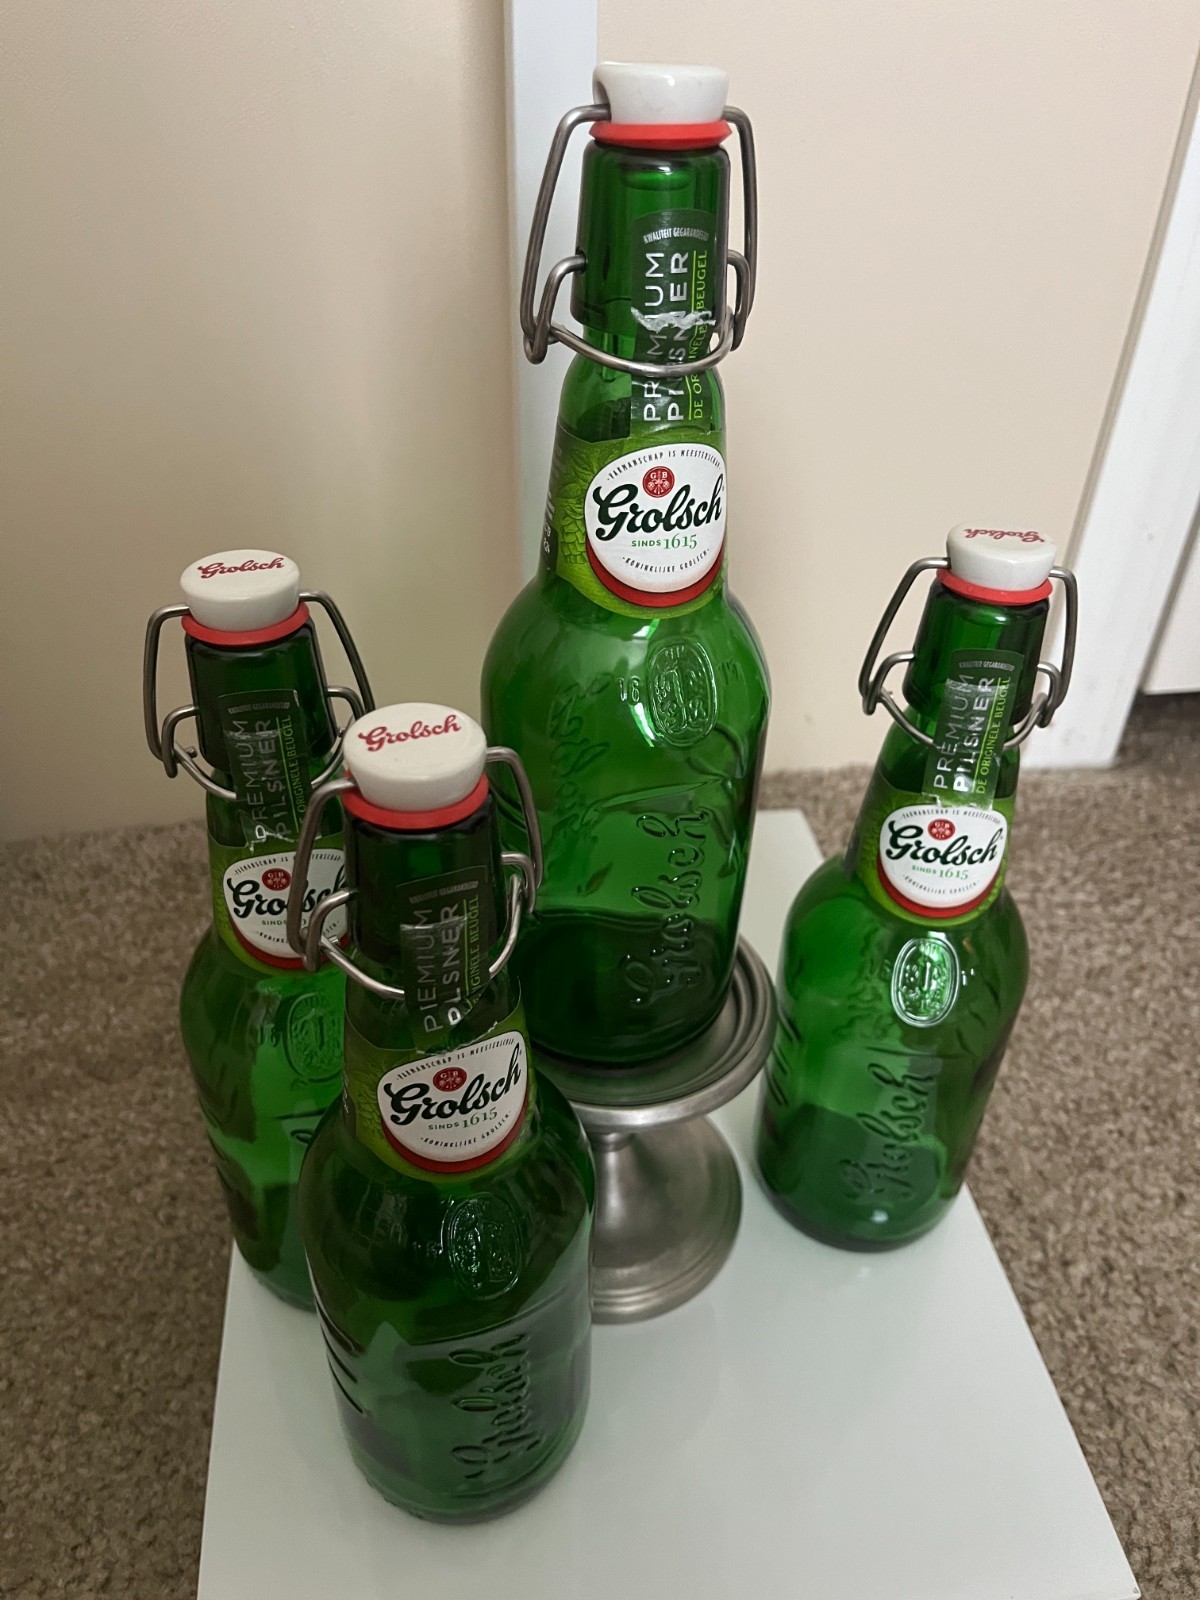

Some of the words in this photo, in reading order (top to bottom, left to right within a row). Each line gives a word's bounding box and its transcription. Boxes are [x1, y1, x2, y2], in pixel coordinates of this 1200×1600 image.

[644, 252, 667, 421] PRMIUM
[693, 400, 703, 419] DE
[668, 449, 677, 458] IS
[592, 473, 724, 541] Grolsch
[664, 532, 698, 549] 1615
[964, 528, 1045, 543] Grolsch
[197, 557, 284, 579] Grolsch
[625, 557, 676, 573] KONINKLIJKE
[680, 550, 707, 570] GROLSCH
[282, 715, 297, 759] BEUGEL
[358, 714, 462, 753] Grolsch
[933, 674, 974, 789] PREMIUM
[953, 677, 995, 792] PILSNER
[980, 720, 1001, 776] ORIGINELE
[233, 720, 268, 839] PREMIUM
[976, 778, 988, 794] DE
[885, 820, 1003, 866] Grolsch
[939, 867, 969, 880] 1615
[469, 894, 479, 944] BEUGEL
[383, 1042, 522, 1126] Grolsch
[428, 1122, 460, 1130] SINDS
[463, 1107, 498, 1128] 1615
